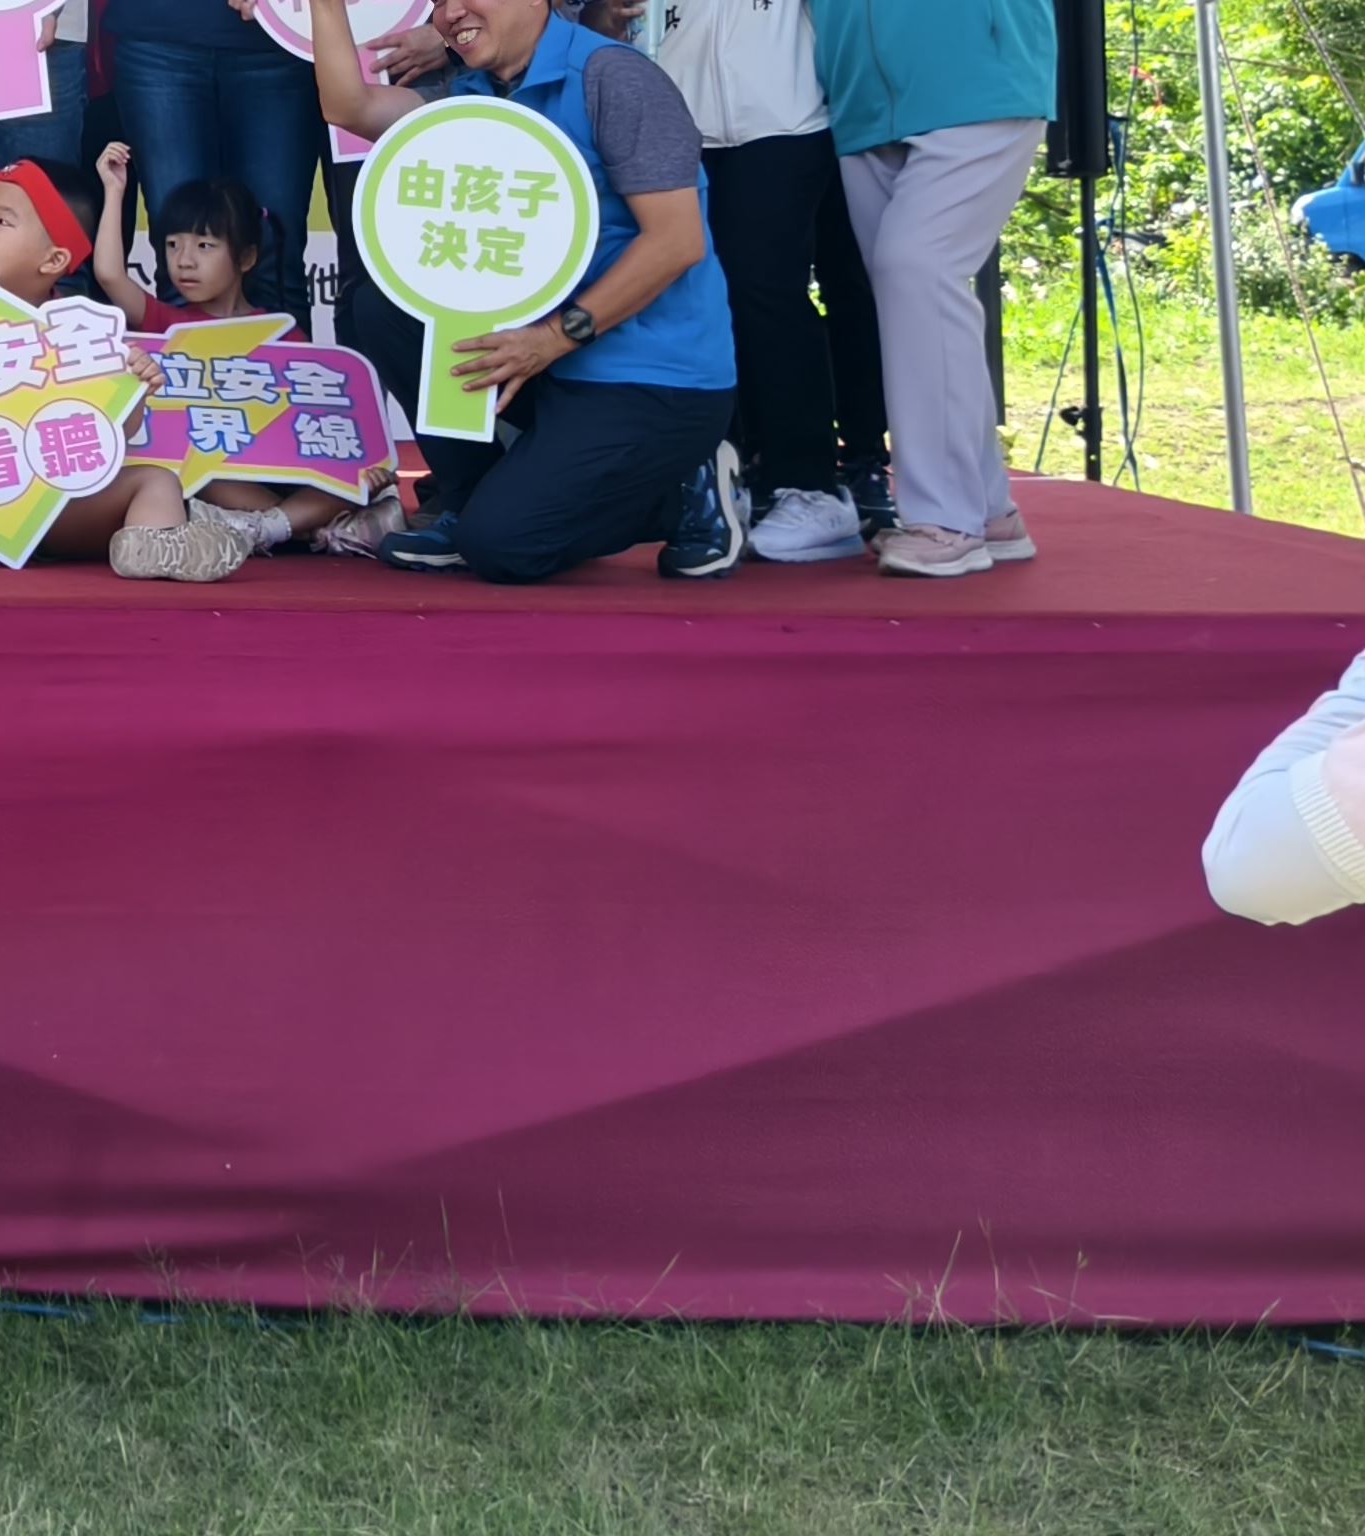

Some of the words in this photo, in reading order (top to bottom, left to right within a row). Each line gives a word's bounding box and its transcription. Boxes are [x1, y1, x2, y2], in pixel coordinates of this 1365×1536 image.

[396, 159, 560, 221] 由孩子
[418, 220, 526, 278] 決定
